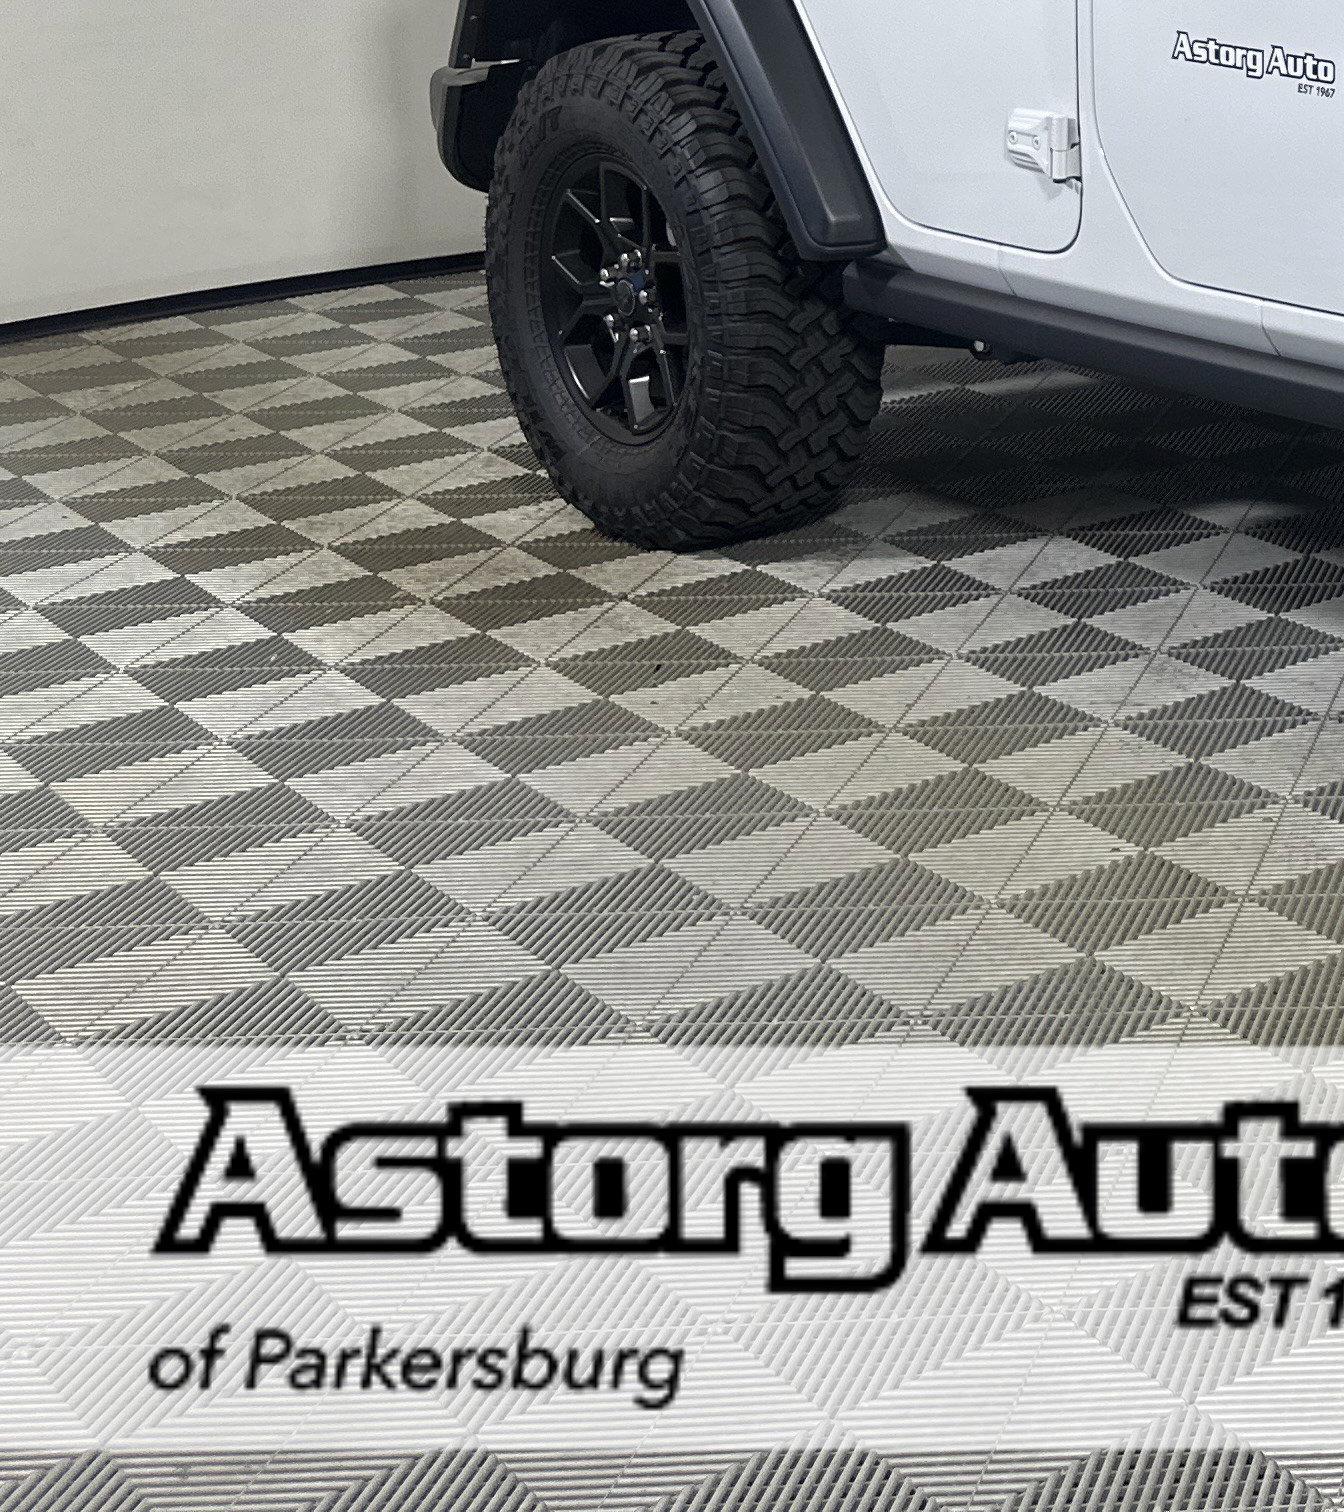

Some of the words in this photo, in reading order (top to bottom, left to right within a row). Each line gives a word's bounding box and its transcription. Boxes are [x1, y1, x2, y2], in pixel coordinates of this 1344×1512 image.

[1172, 30, 1265, 79] Astorg
[1266, 45, 1336, 84] Auto
[1297, 83, 1314, 96] EST
[1316, 85, 1336, 99] 1967
